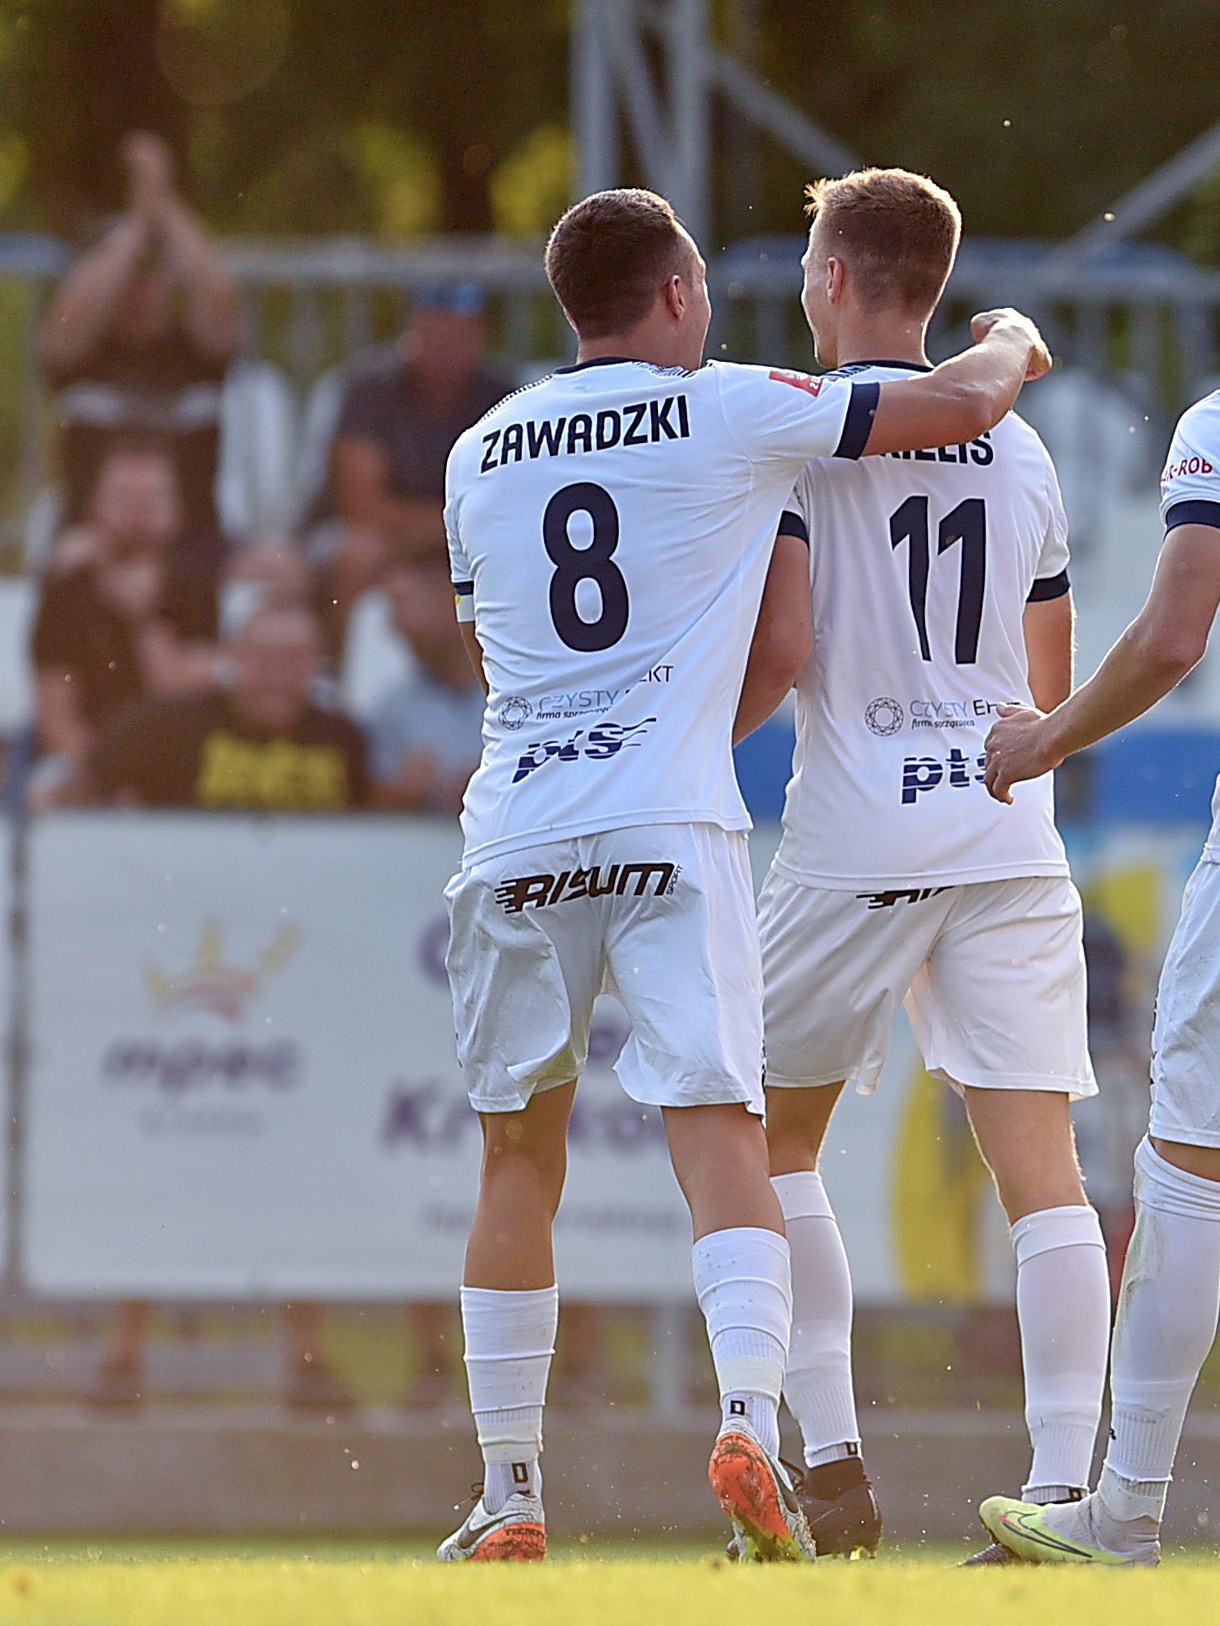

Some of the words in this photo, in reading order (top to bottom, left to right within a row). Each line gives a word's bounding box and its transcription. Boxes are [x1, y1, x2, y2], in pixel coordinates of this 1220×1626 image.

[480, 395, 690, 473] ZAWADZKI
[543, 481, 630, 653] 8
[890, 495, 986, 665] 11
[910, 700, 968, 718] CZYSTY
[494, 863, 675, 914] RISUM
